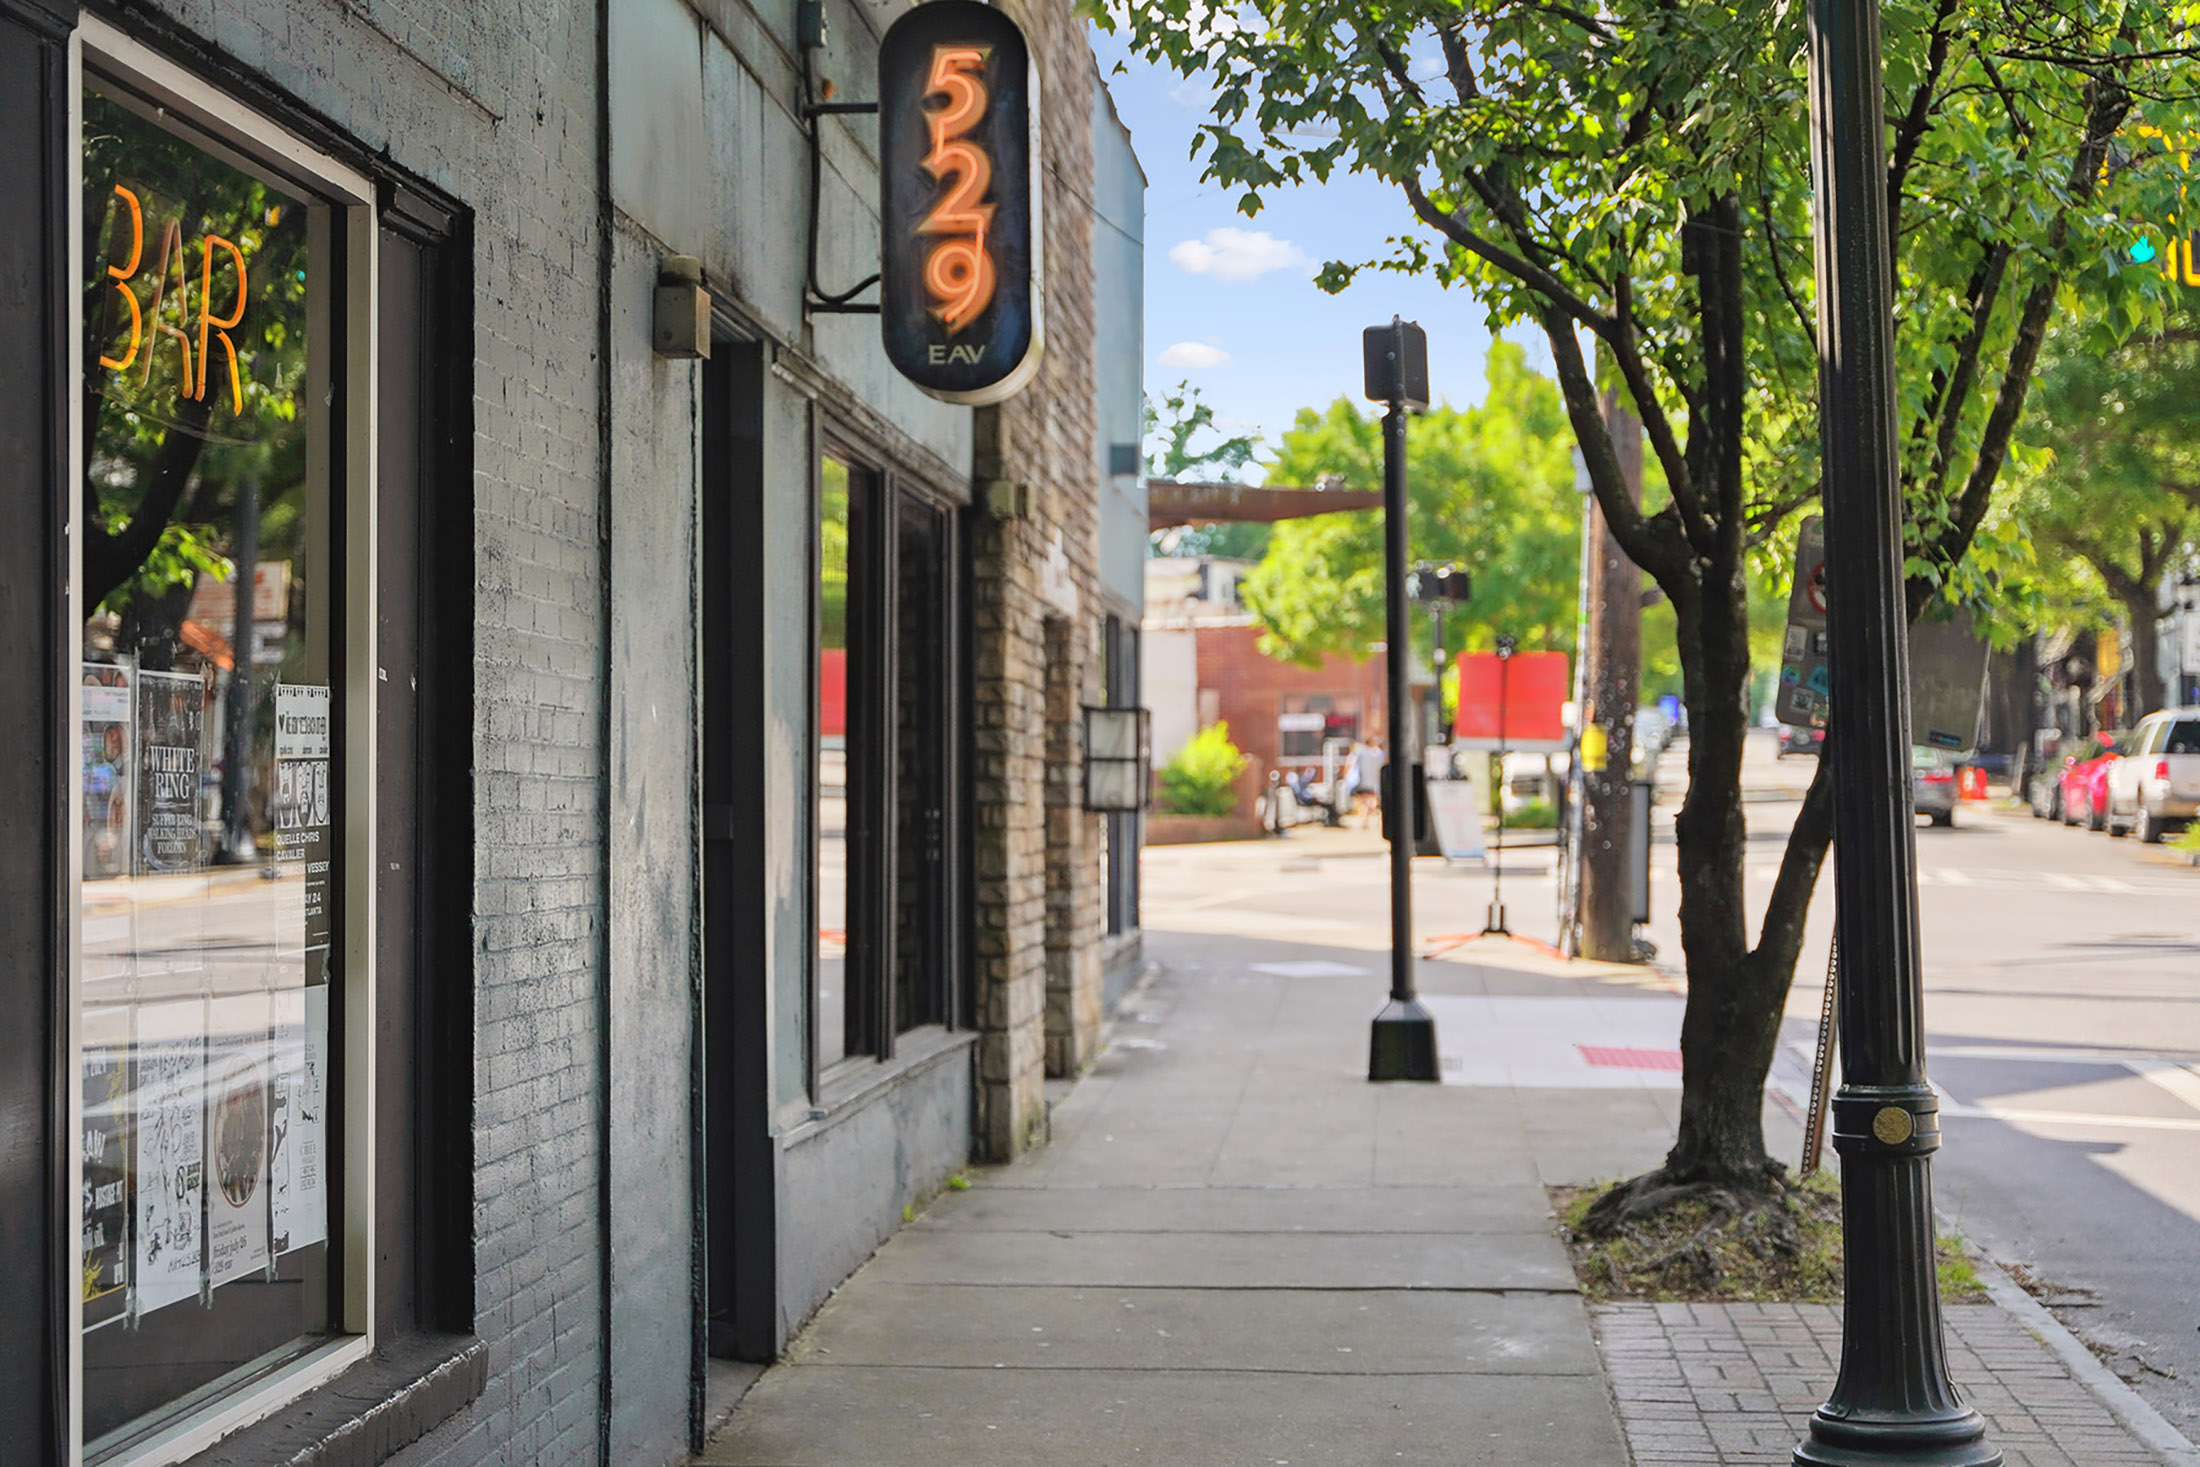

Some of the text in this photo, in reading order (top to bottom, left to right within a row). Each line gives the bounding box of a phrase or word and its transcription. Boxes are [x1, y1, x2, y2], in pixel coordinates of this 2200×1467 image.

[99, 184, 248, 418] BAR
[928, 344, 986, 366] EAV
[149, 745, 195, 774] WHITE
[155, 772, 190, 800] RING
[276, 831, 320, 846] QUELLE CHRIS
[307, 860, 330, 874] VESSEY
